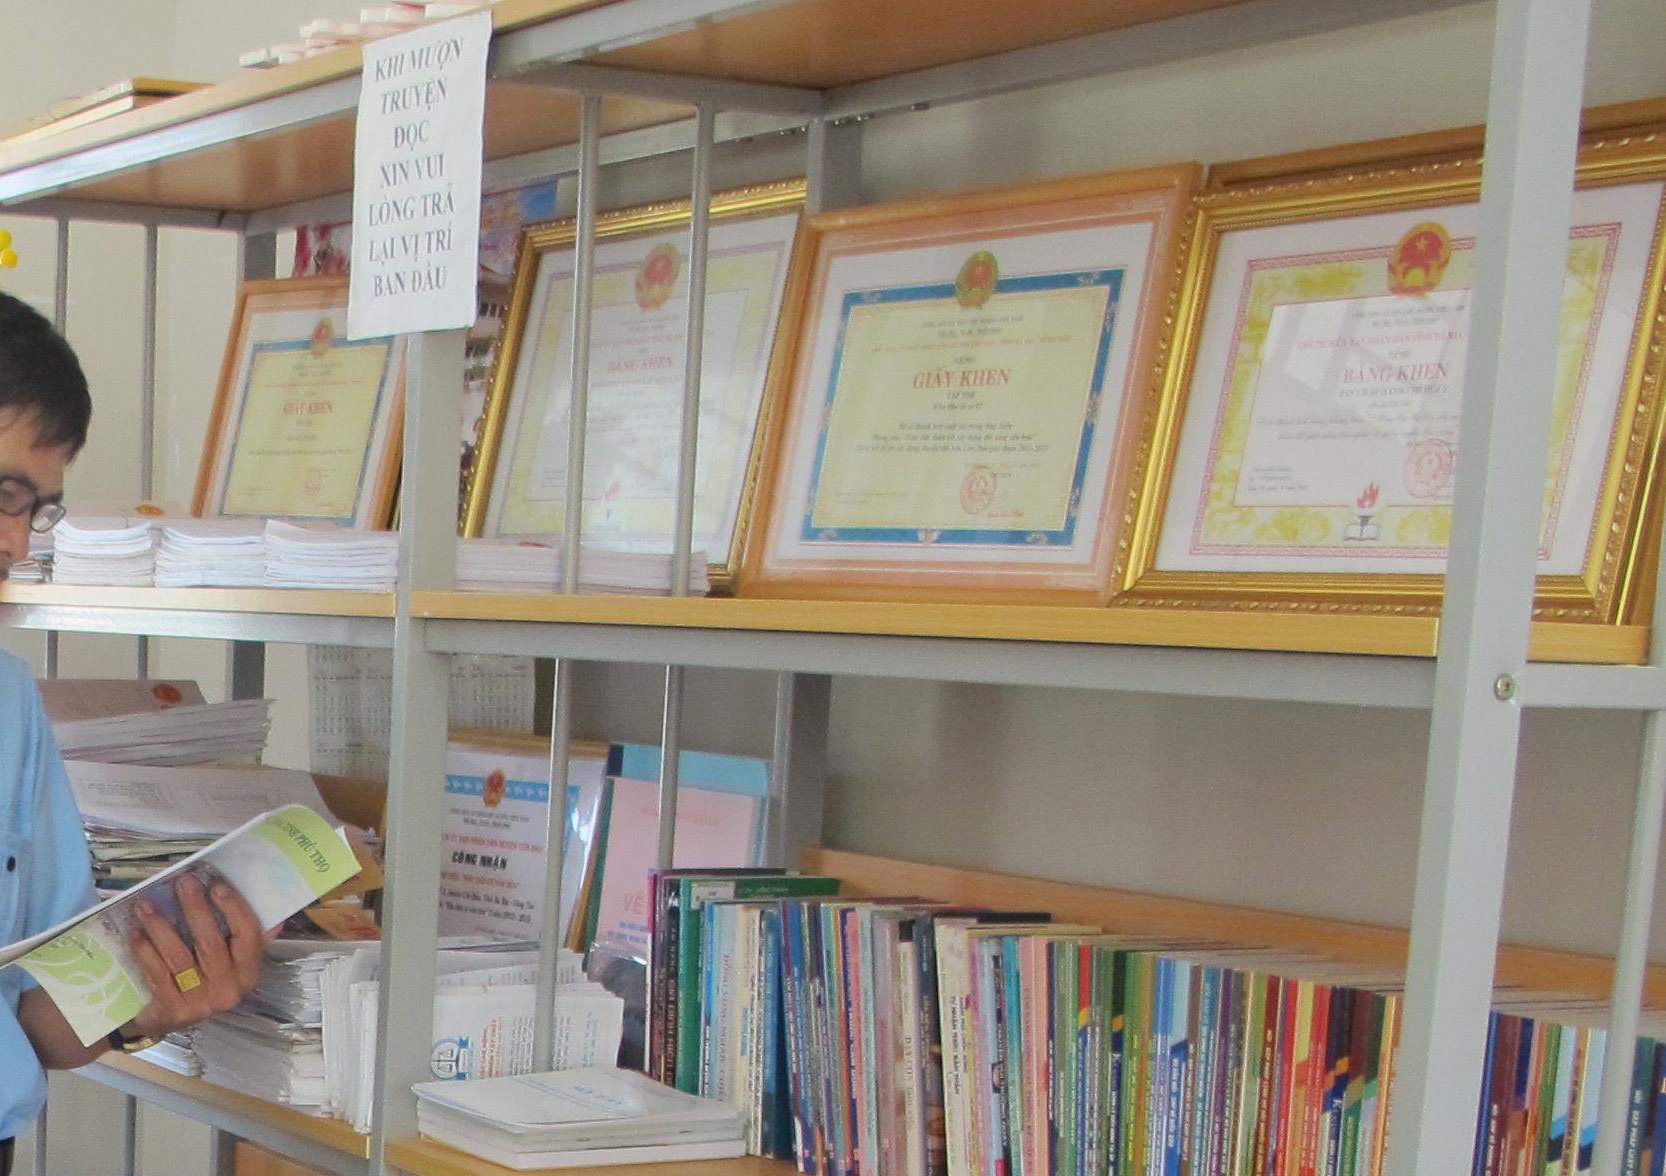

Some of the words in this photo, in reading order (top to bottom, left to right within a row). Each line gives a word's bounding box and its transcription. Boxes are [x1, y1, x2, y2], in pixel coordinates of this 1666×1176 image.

[375, 53, 405, 82] KHI
[411, 38, 464, 71] MƯỢN
[381, 78, 447, 115] TRUYỆN
[393, 120, 430, 151] ĐỌC
[379, 160, 409, 189] XIN
[415, 154, 446, 181] VUI
[369, 193, 415, 227] LÒNG
[422, 182, 454, 215] TRẢ
[369, 235, 399, 266] LẠI
[402, 234, 419, 263] VỊ
[426, 221, 453, 252] TRÍ
[374, 270, 406, 297] BAN
[411, 263, 447, 293] ĐẦU
[912, 365, 956, 389] GIẤY
[959, 368, 1011, 388] KHEN
[1397, 362, 1449, 381] KHEN
[295, 833, 318, 852] PHÚ
[309, 849, 331, 873] THỌ
[452, 850, 477, 865] CÔNG
[479, 855, 507, 871] NHẬN
